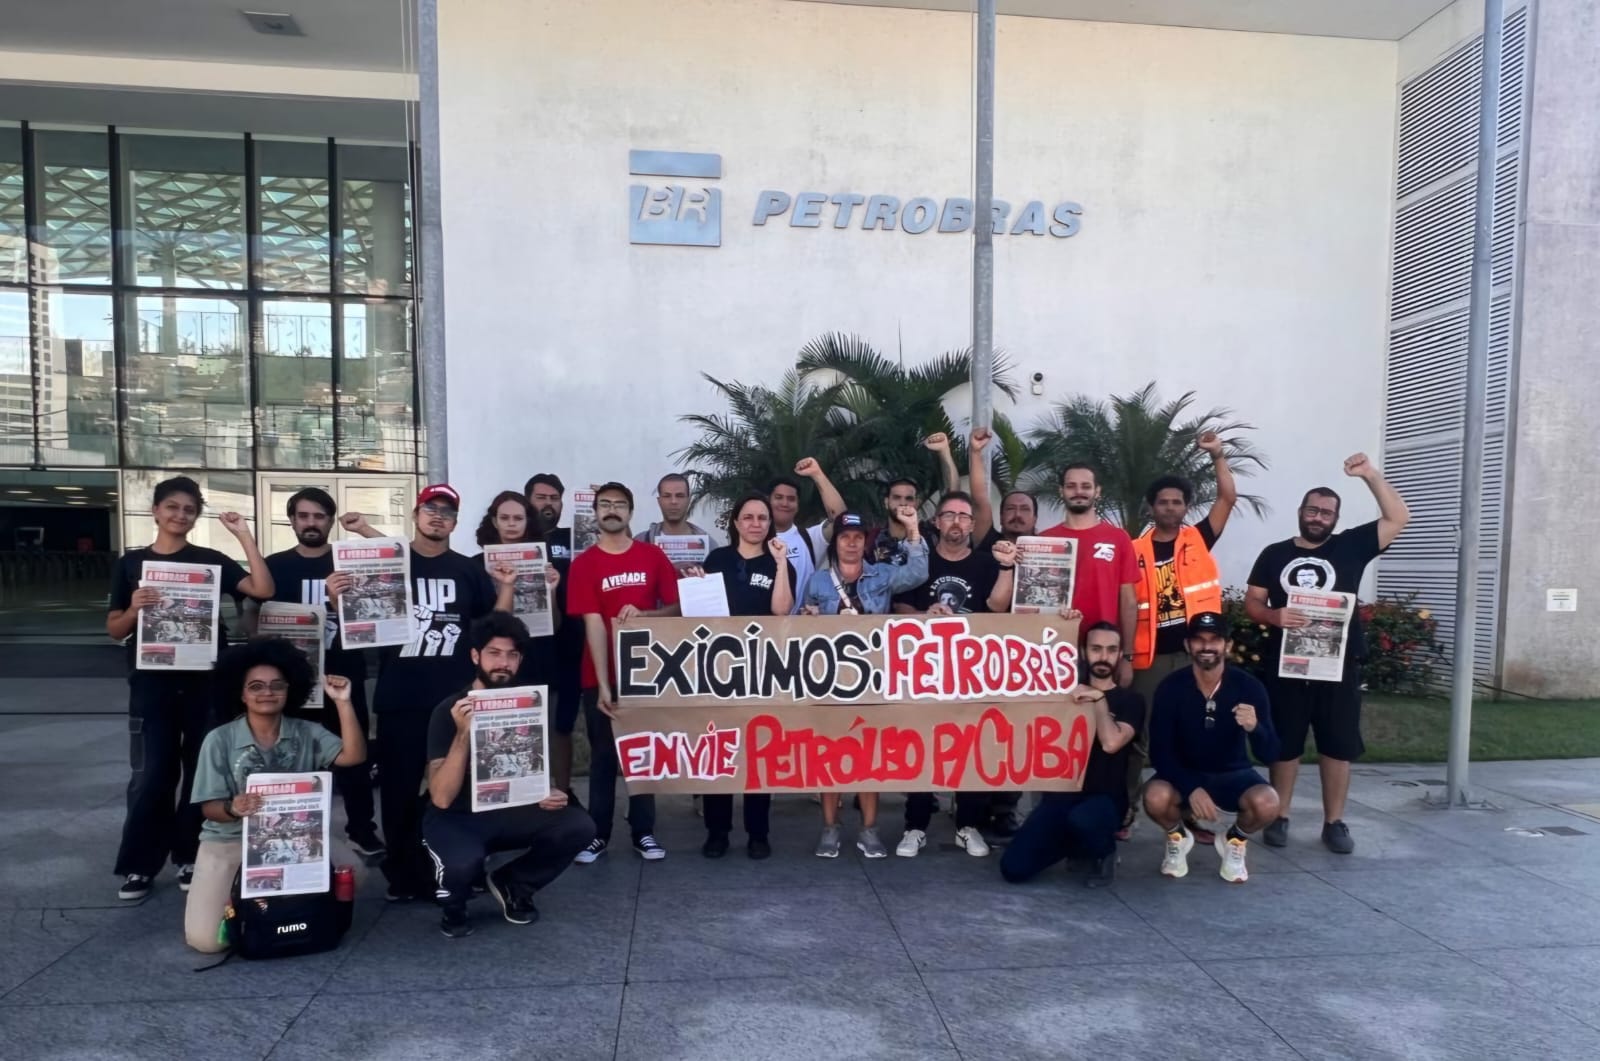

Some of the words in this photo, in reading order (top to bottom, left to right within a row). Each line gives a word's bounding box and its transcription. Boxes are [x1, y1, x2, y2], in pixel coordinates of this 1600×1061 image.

[752, 190, 1083, 239] PETROBRAS
[417, 578, 456, 612] UP
[482, 698, 517, 710] VERDADE
[616, 720, 740, 781] ENVIE
[745, 714, 926, 790] PETRÓLEO
[277, 922, 307, 934] rumo
